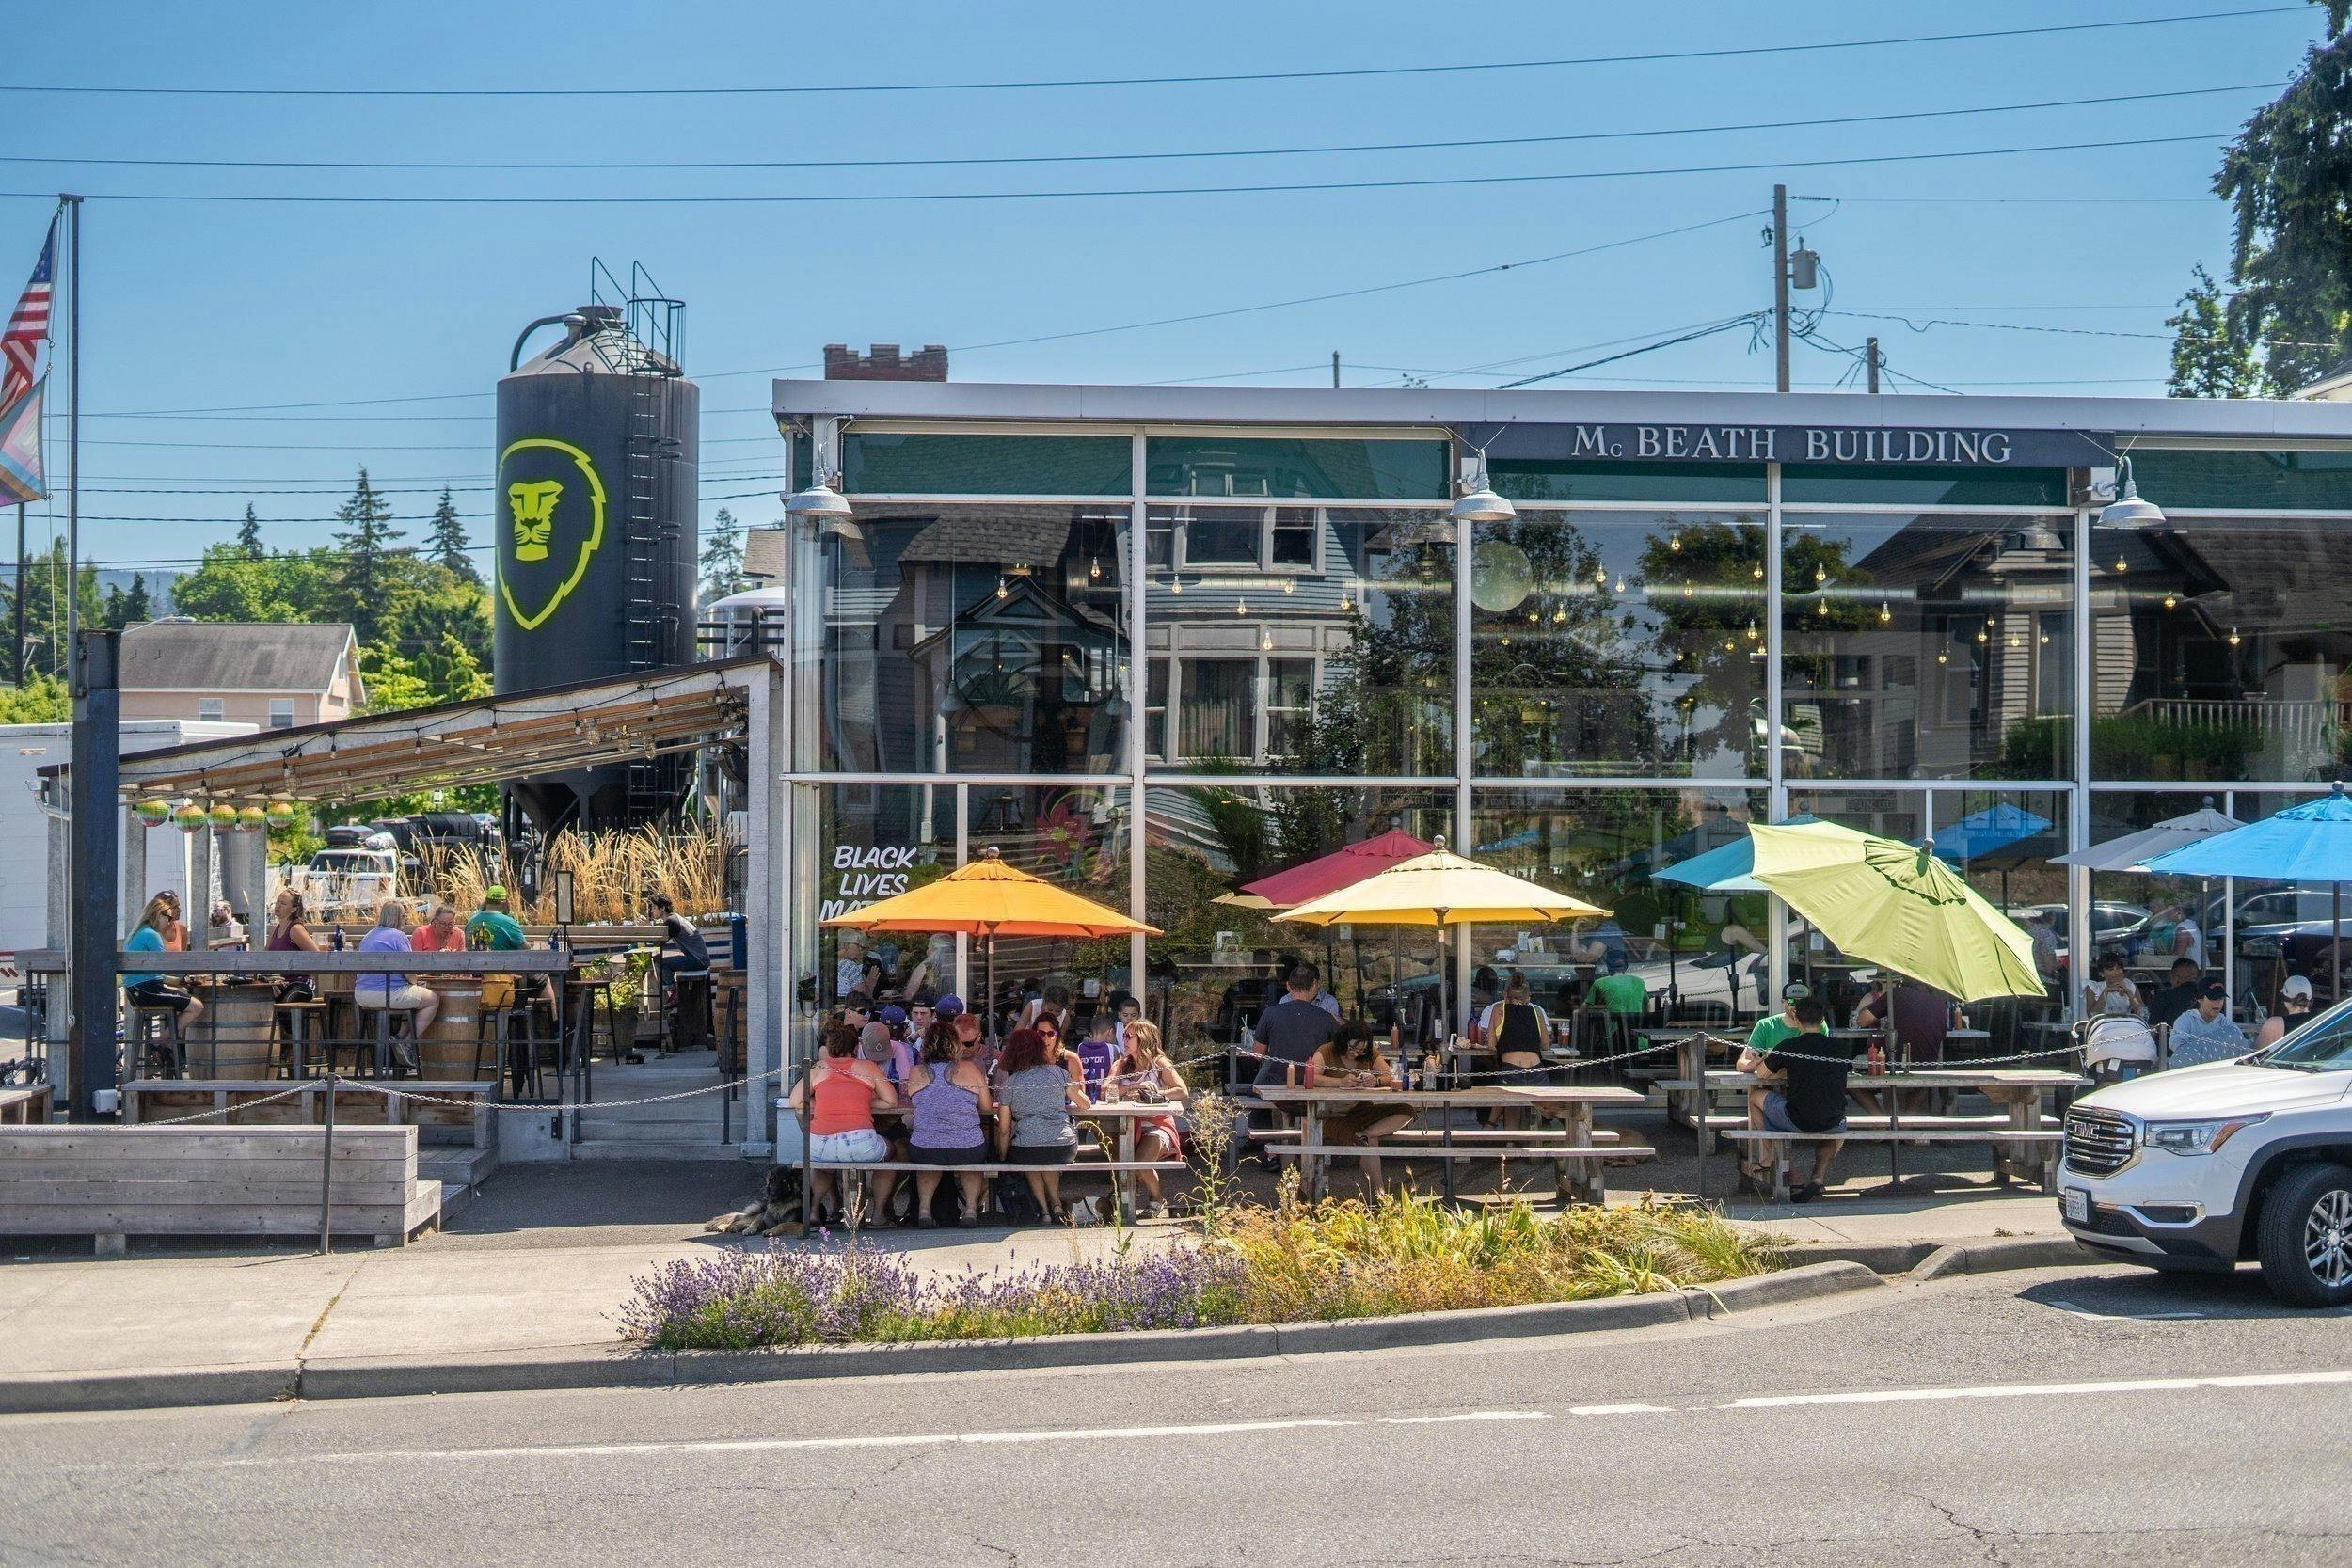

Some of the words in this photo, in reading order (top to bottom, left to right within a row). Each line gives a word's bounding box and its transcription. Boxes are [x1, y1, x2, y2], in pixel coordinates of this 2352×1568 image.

[1637, 426, 1776, 459] BEATH
[1805, 429, 2013, 463] BUILDING
[834, 846, 917, 869] BLACK
[839, 873, 909, 896] LIVES
[2074, 1122, 2100, 1139] GMC
